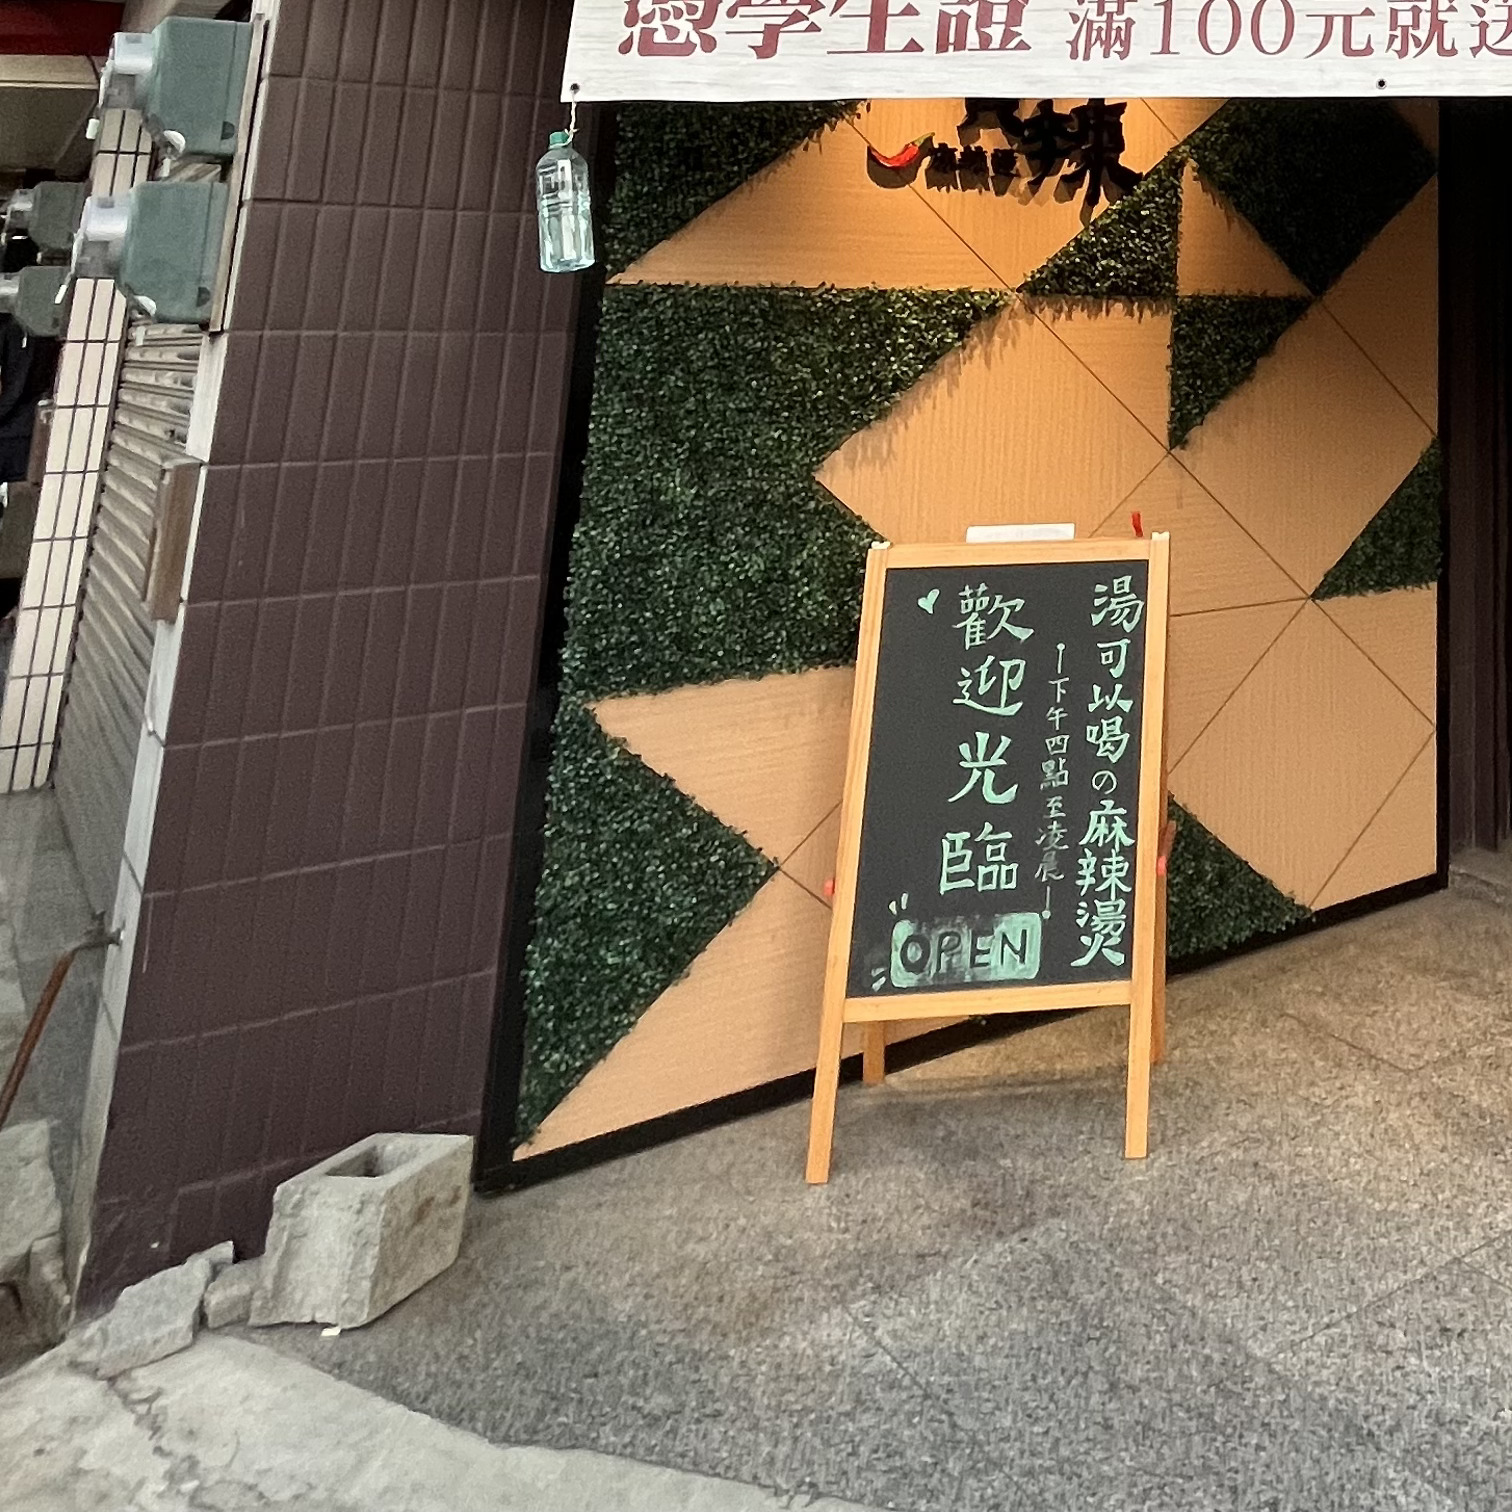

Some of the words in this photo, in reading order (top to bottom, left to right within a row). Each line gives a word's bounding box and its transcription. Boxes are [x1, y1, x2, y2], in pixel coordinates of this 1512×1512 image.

[940, 582, 1035, 895] 歡迎光臨
[1070, 575, 1144, 968] 湯可以喝の麻辣燙
[900, 928, 1028, 975] OPEN
